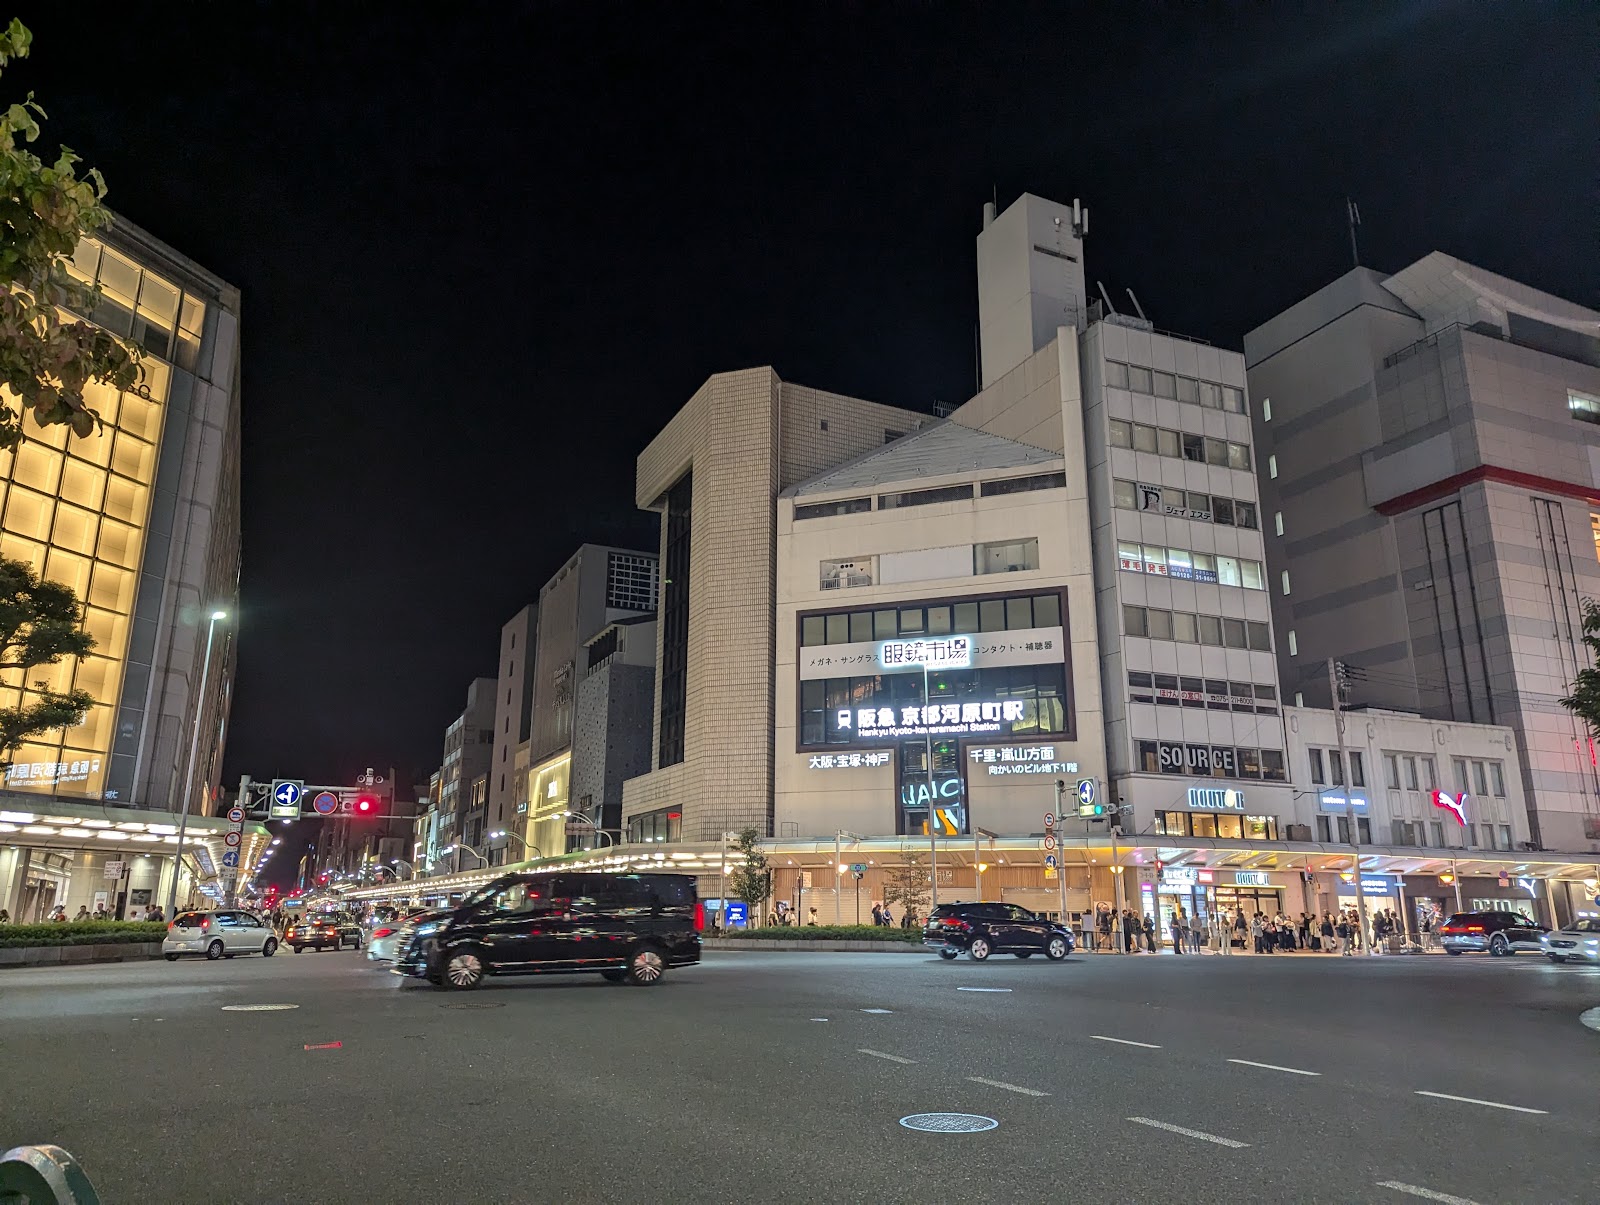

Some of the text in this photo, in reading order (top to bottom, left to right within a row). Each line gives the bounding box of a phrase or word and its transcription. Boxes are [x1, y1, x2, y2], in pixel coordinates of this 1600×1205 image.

[884, 638, 968, 664] 眼鏡市場
[973, 640, 1053, 654] コンタクト・補聴器
[809, 654, 880, 667] メガネ・サングラス
[857, 700, 1024, 728] 阪急 京都河原町駅
[858, 726, 888, 738] Hankyu
[970, 722, 1000, 733] Station
[809, 752, 890, 770] 大阪・宝塚・神戸
[970, 746, 1054, 764] 千里・嵐山方面
[1161, 746, 1233, 770] SOURCE
[988, 763, 1078, 776] 向かいのビル地下1階
[1188, 787, 1245, 810] DOUTOR
